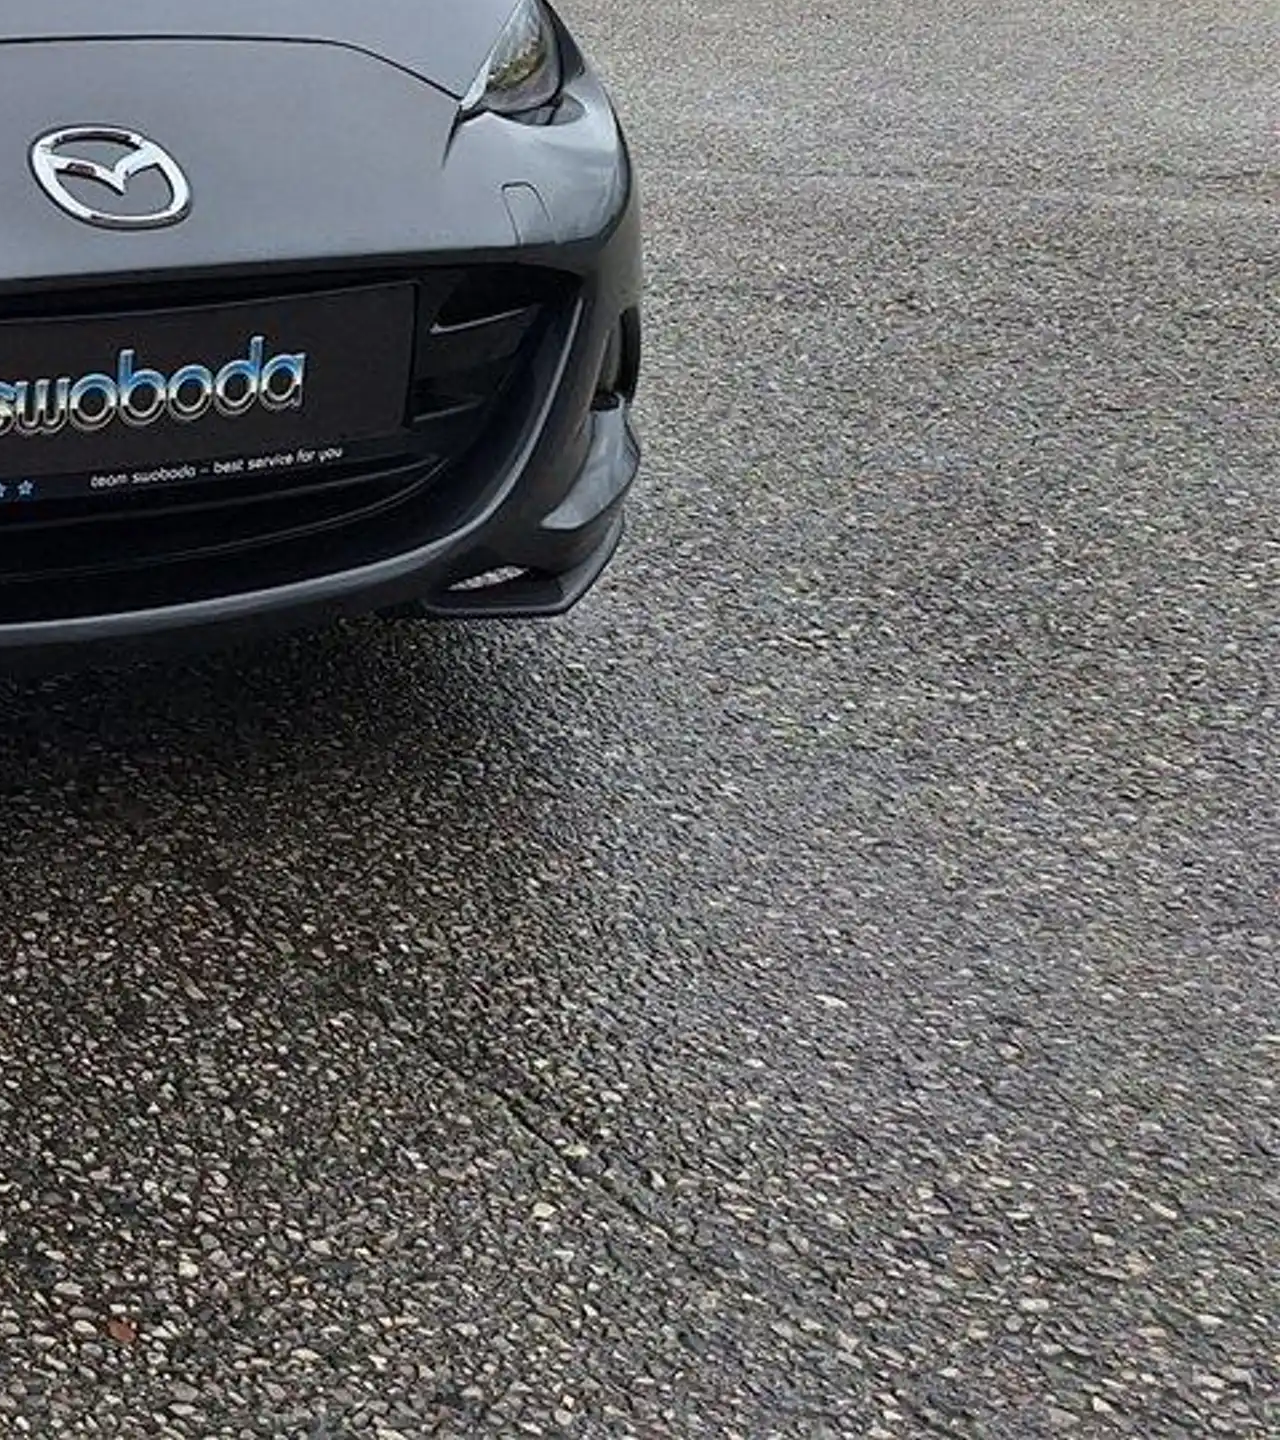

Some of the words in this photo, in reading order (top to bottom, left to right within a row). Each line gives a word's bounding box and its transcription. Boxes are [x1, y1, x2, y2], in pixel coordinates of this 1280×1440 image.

[132, 464, 196, 483] swoboda
[213, 459, 244, 474] best
[248, 453, 294, 471] service
[296, 448, 316, 463] for
[318, 447, 343, 463] you
